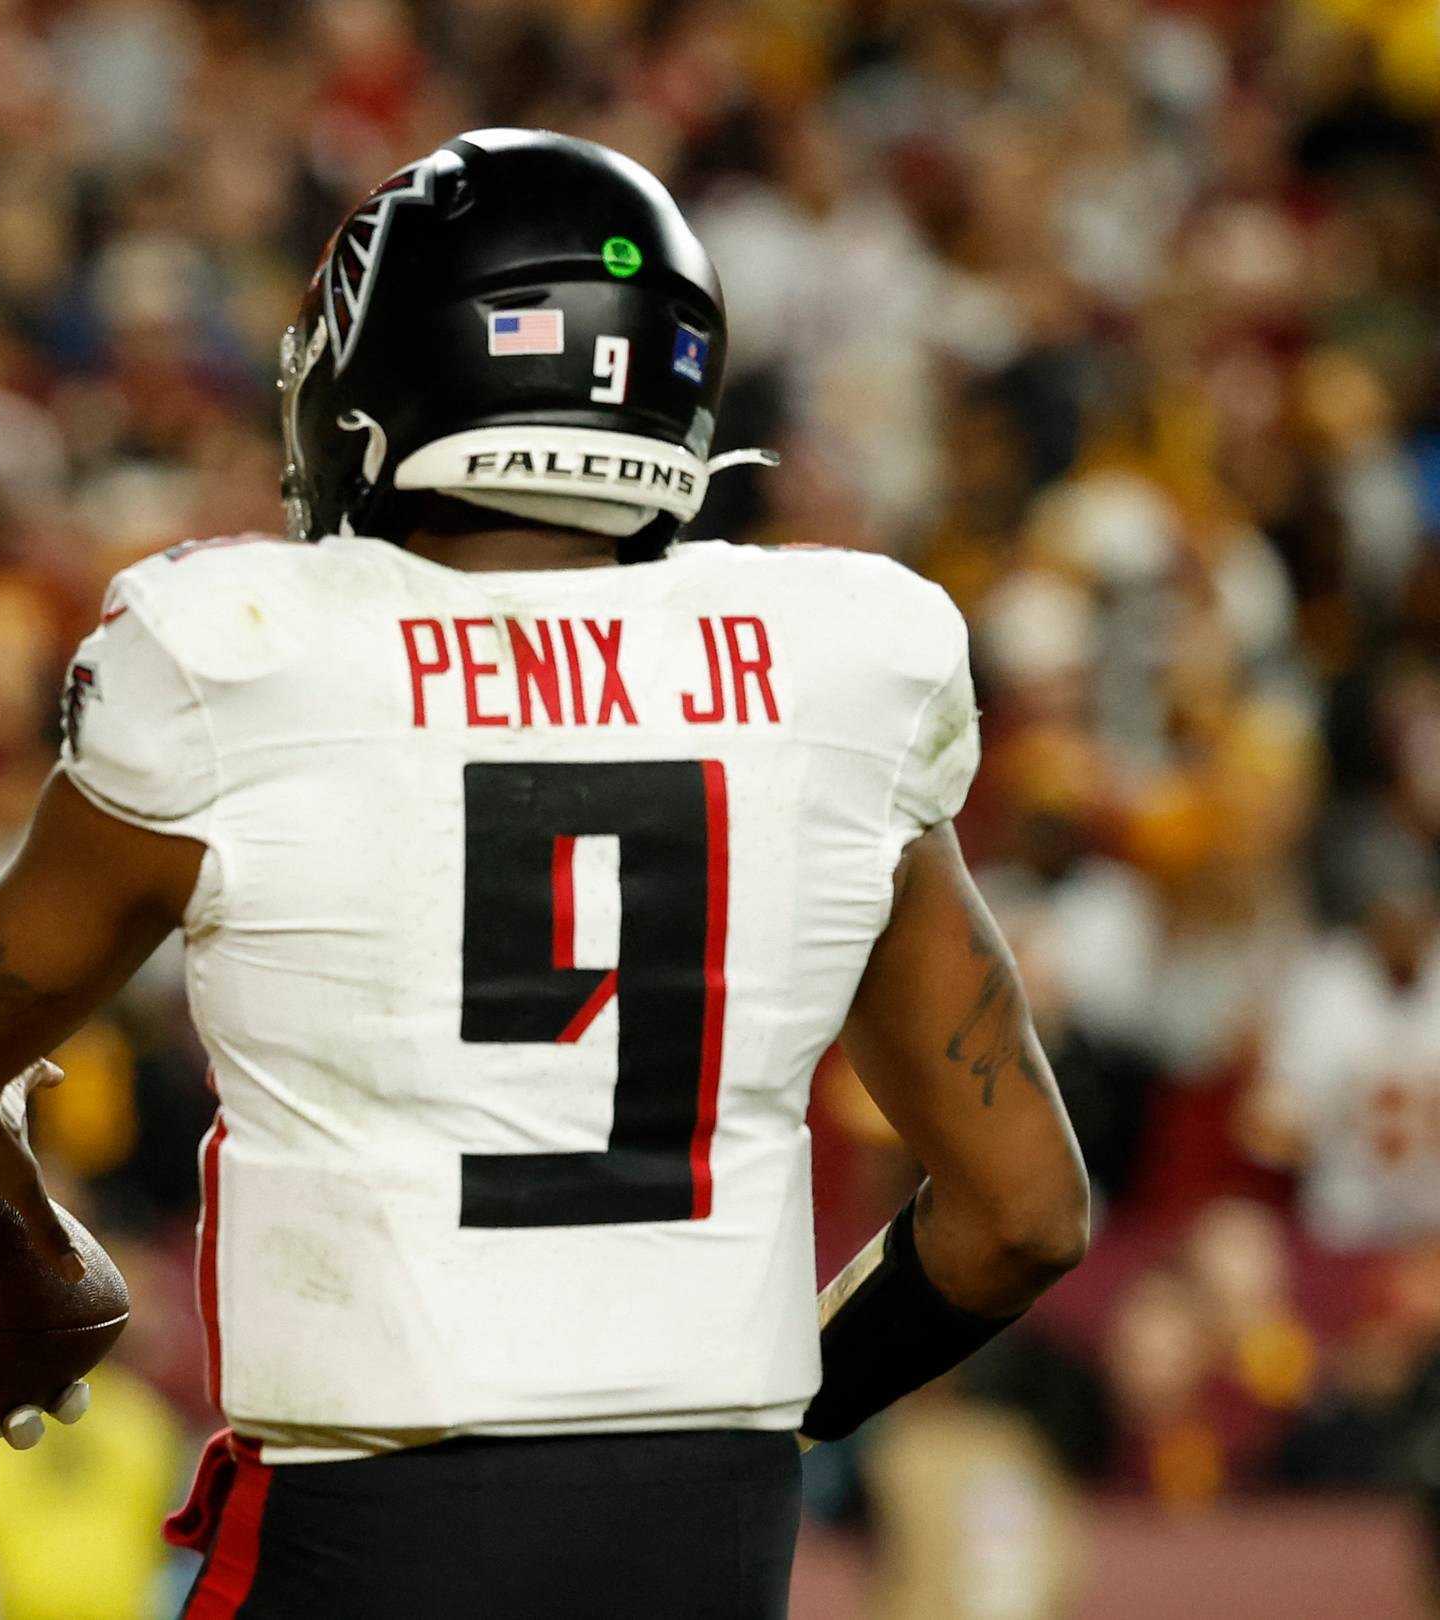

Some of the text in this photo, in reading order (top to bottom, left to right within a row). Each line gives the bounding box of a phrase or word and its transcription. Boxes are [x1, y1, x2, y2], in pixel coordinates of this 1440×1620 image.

[590, 333, 631, 405] 9
[465, 450, 696, 496] FALCONS
[398, 615, 781, 728] PENIX JR
[459, 758, 729, 1229] 9
